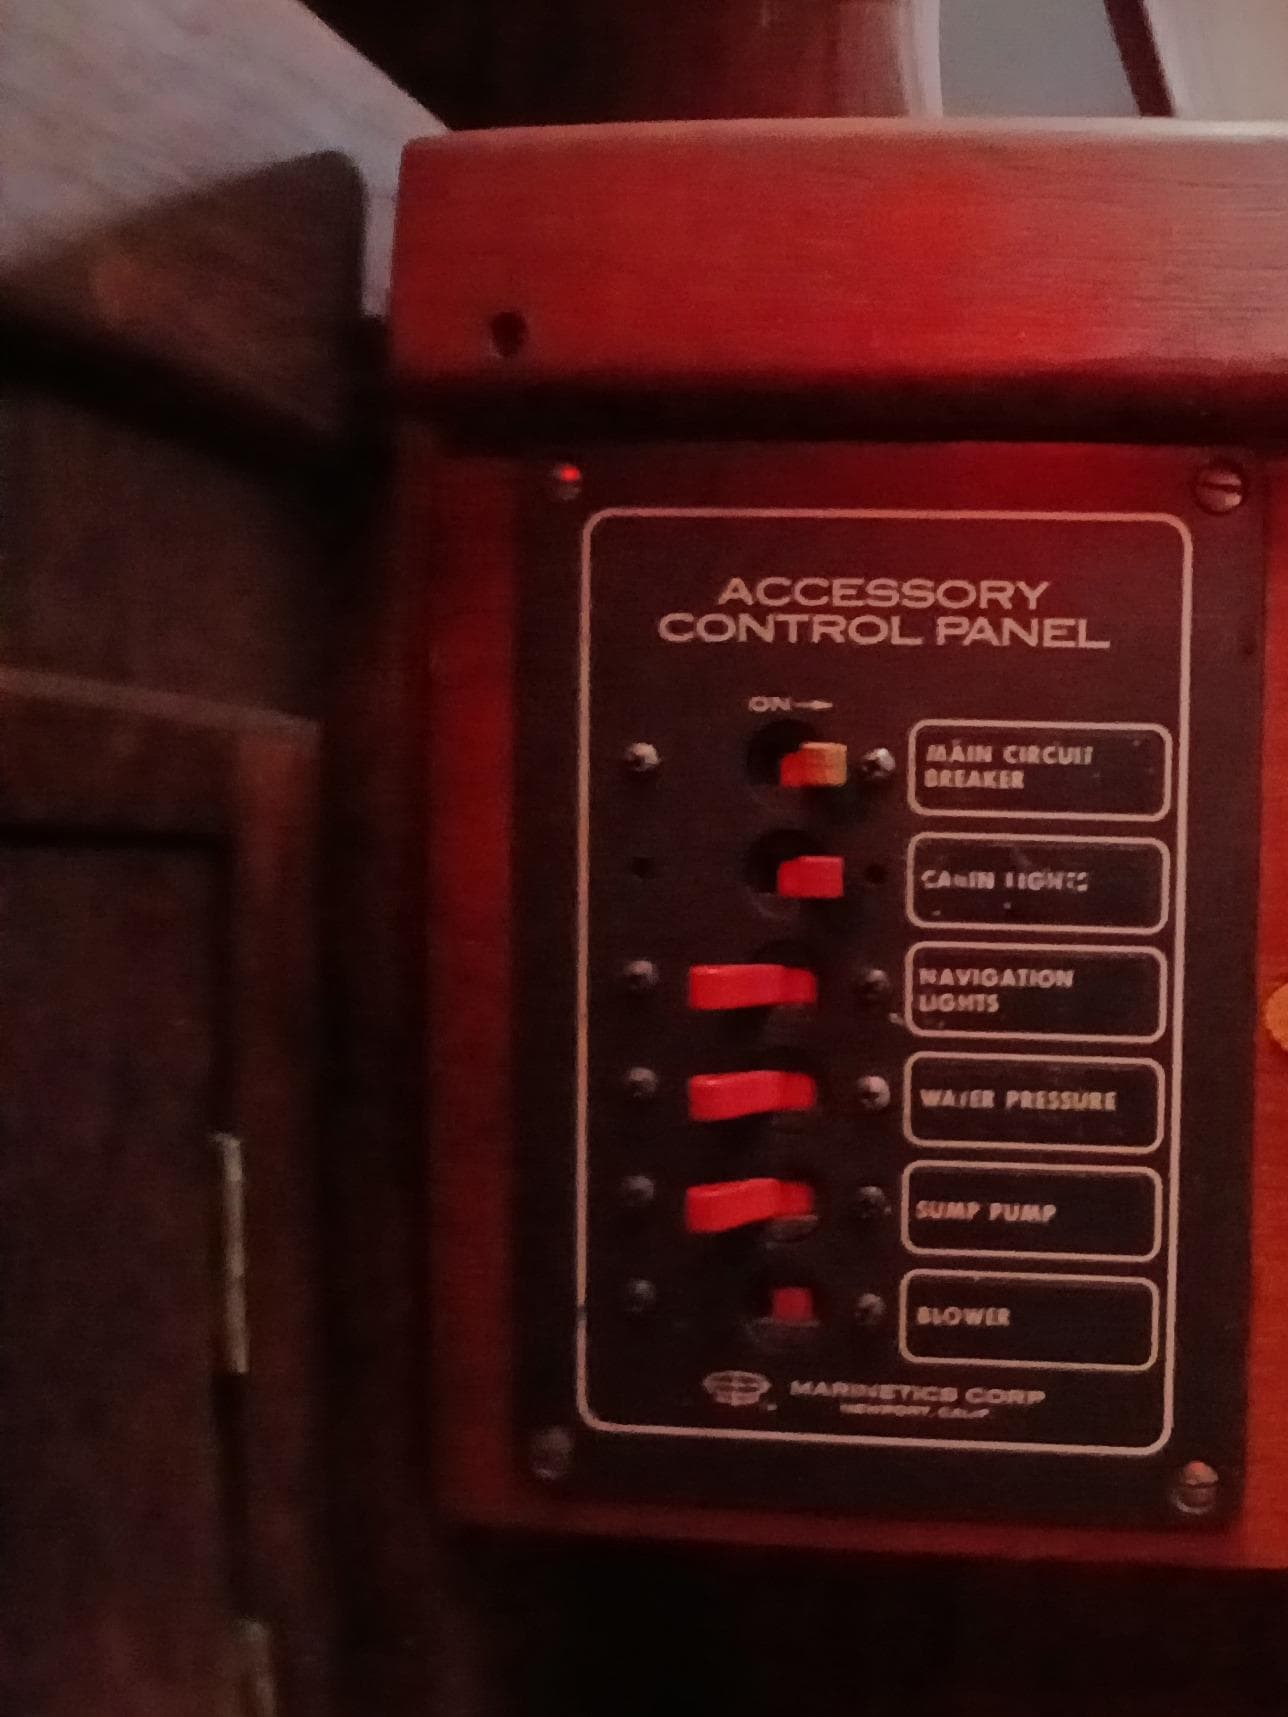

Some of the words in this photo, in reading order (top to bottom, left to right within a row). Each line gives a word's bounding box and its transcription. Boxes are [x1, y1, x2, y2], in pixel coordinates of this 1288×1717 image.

[717, 576, 1050, 611] ACCESSORY
[657, 612, 924, 646] CONTROL
[936, 616, 1110, 650] PANEL
[748, 697, 792, 712] ON
[926, 744, 992, 763] MAIN
[1003, 745, 1094, 765] CIRCUIT
[924, 770, 1025, 789] BREAKER
[919, 968, 1074, 989] NAVIGATION
[919, 993, 999, 1013] LIGHTS
[1004, 1089, 1117, 1111] PRESSURE
[915, 1200, 981, 1220] SUMP
[989, 1202, 1057, 1222] PUMP
[916, 1306, 1011, 1326] BLOWER
[790, 1380, 958, 1401] MARINETICS
[965, 1387, 1046, 1404] CORP
